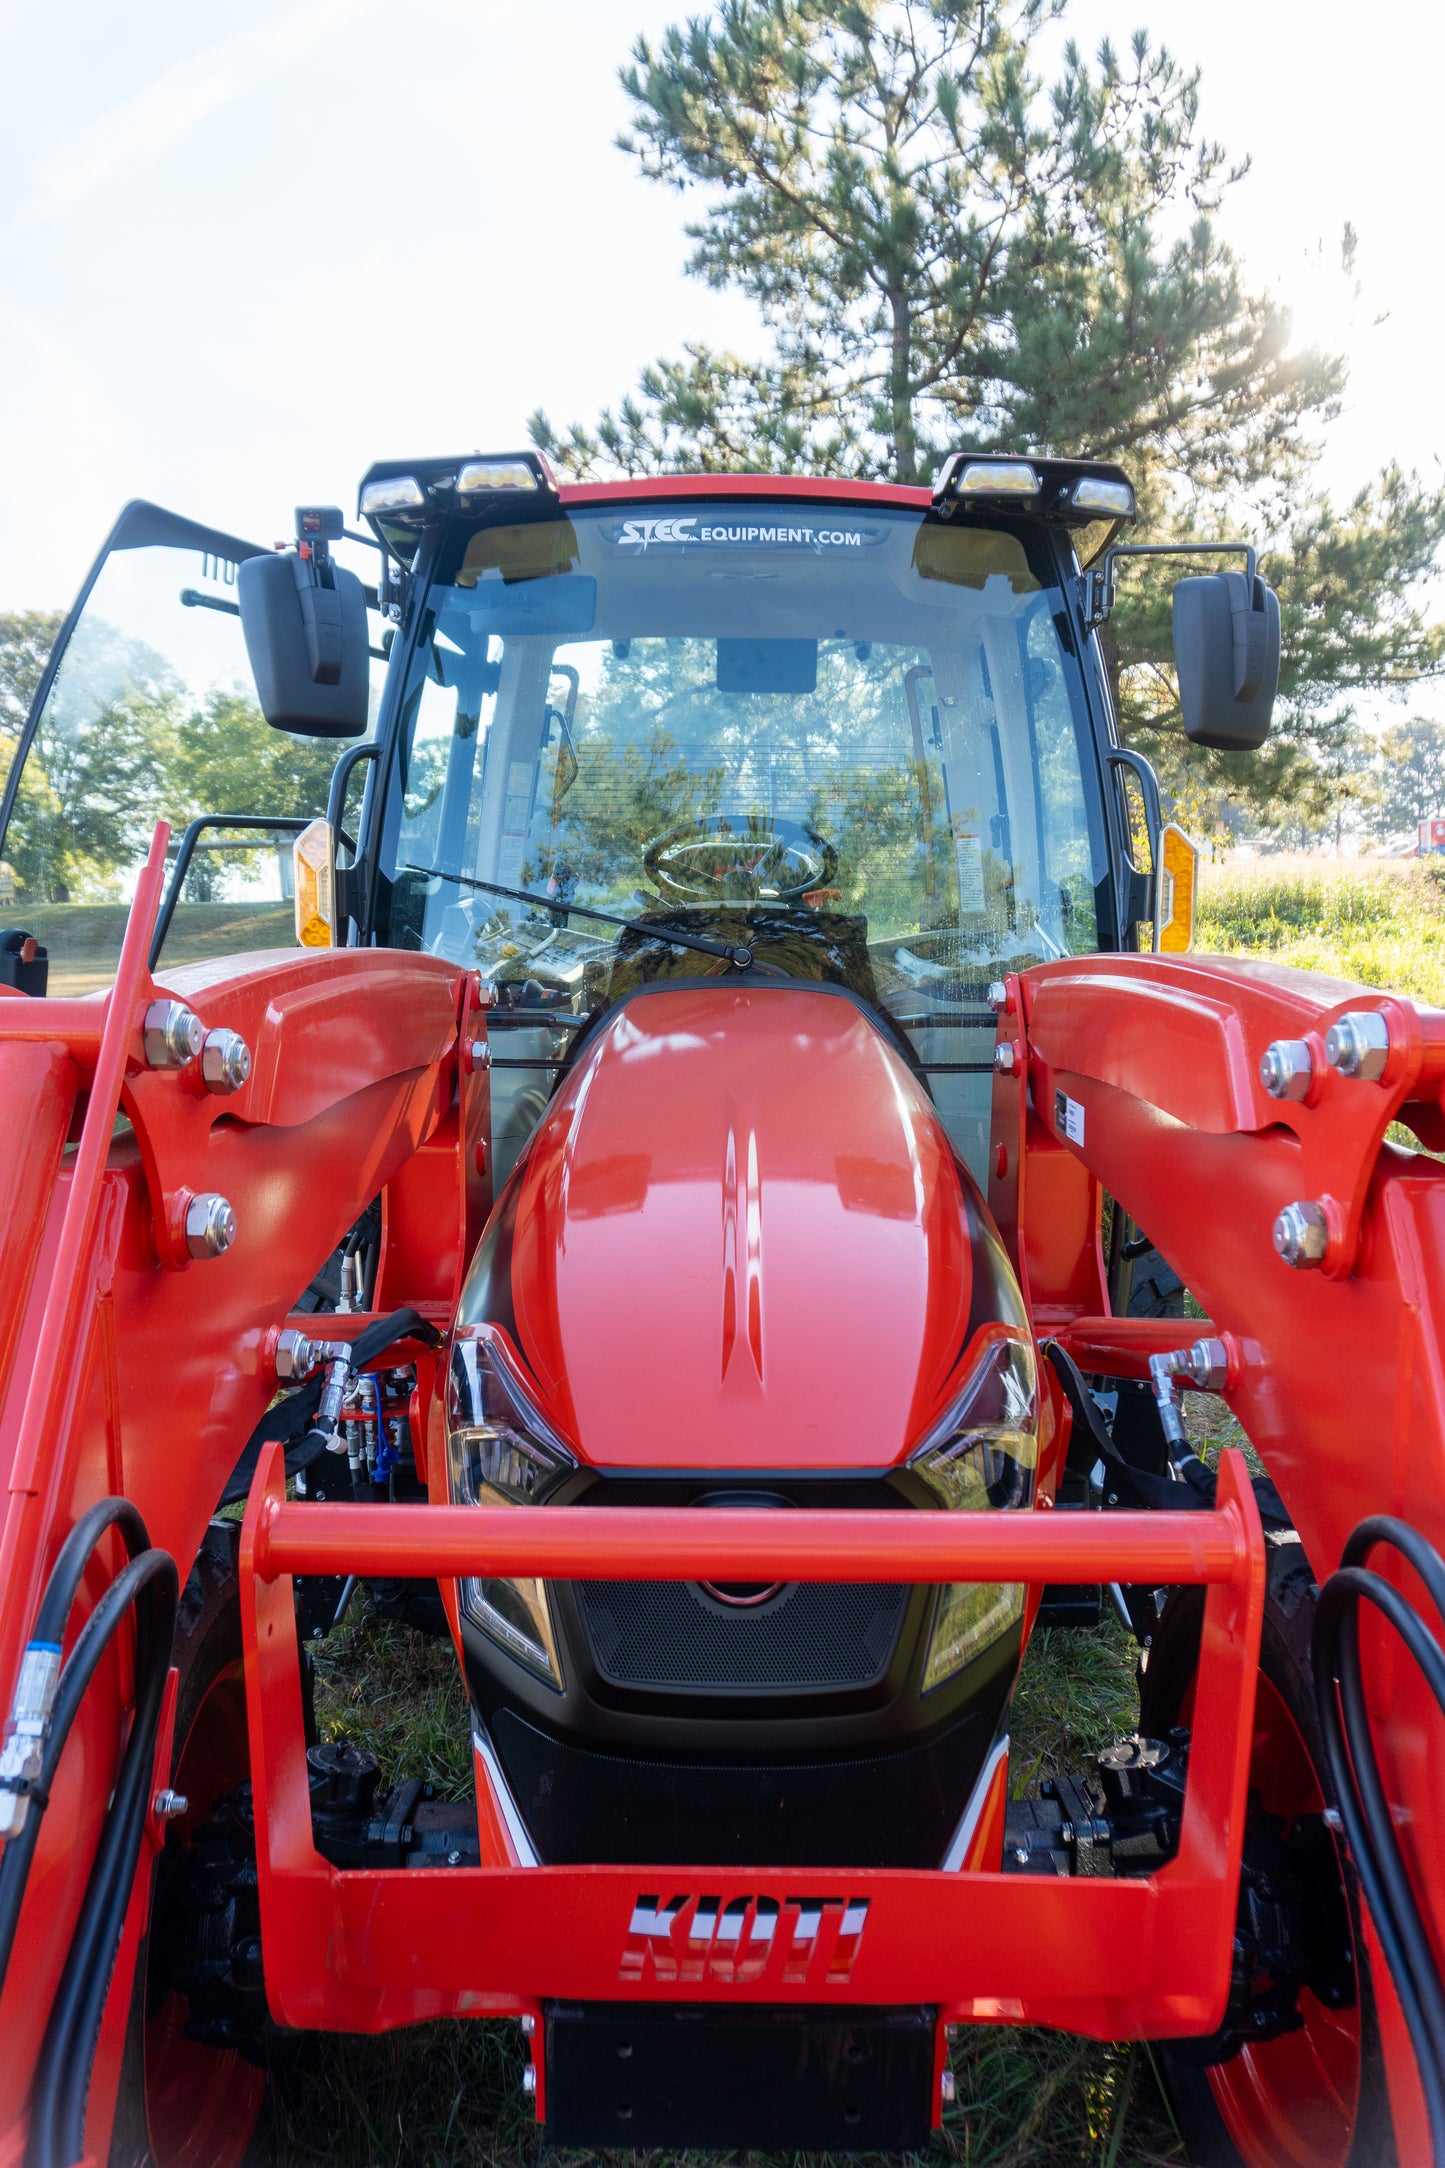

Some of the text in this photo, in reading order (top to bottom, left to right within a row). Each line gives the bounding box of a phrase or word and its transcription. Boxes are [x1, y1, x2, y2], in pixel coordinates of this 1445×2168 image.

[618, 518, 861, 548] STEC EQUIPMENT.COM
[618, 1895, 872, 1984] KIOTI
